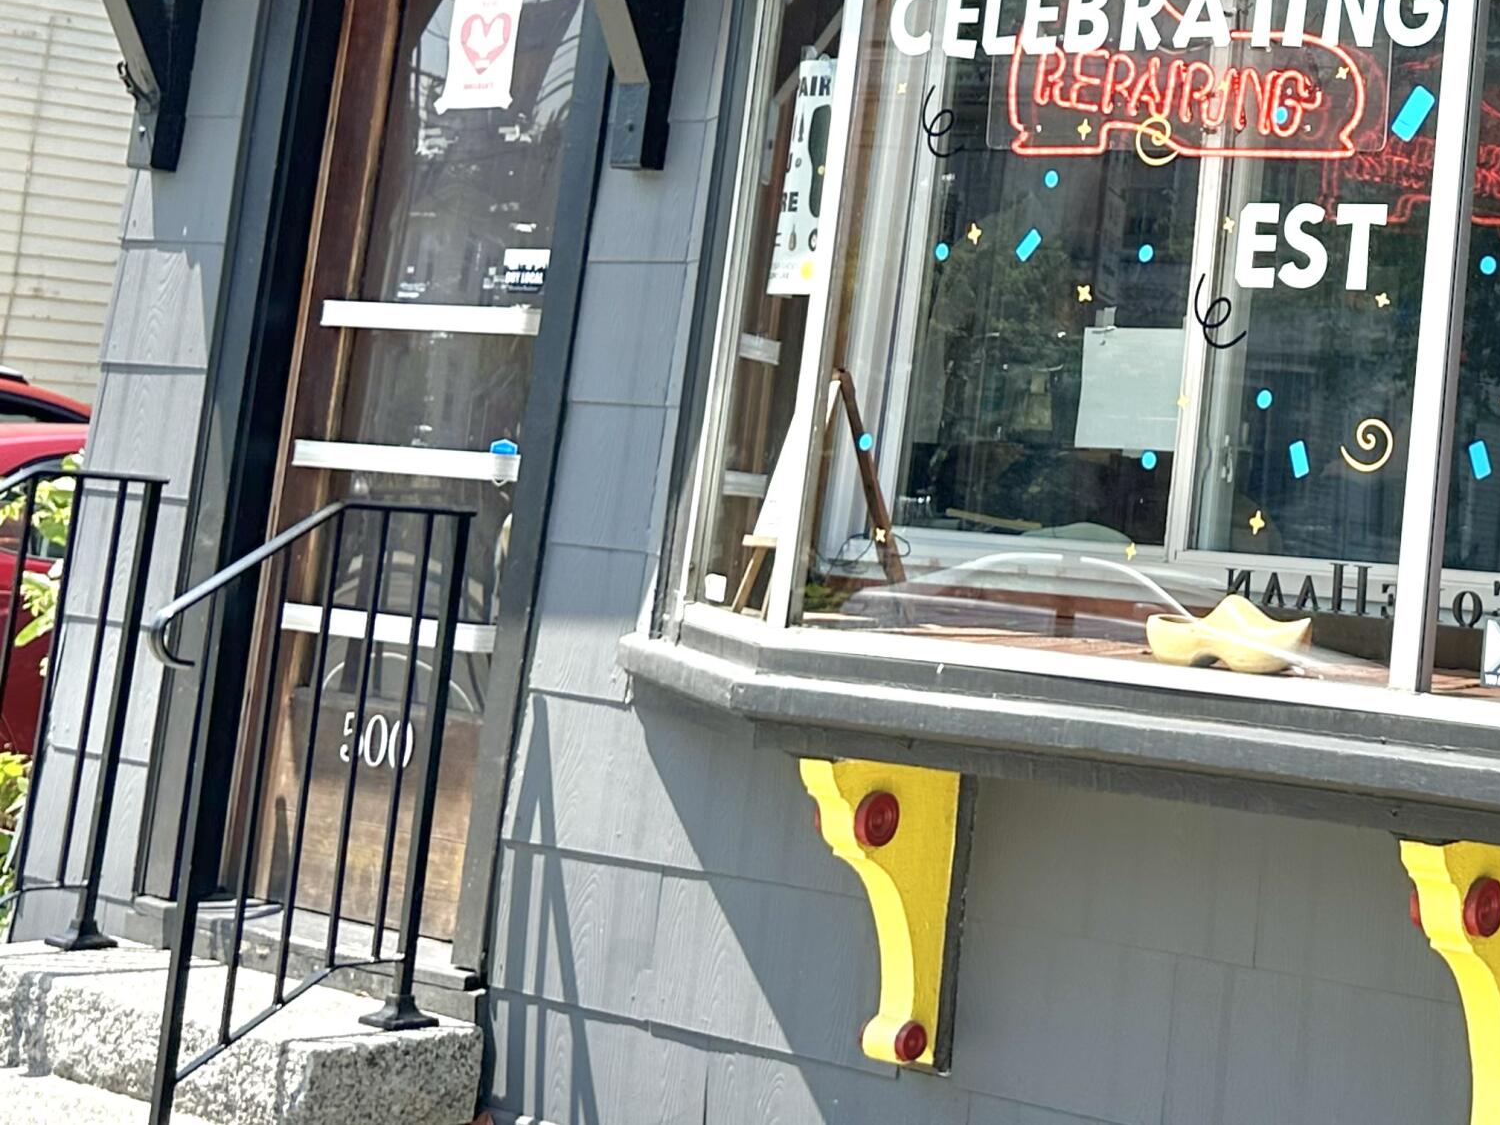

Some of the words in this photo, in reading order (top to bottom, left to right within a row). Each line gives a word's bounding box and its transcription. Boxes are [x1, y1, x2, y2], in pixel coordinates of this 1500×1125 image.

[1033, 45, 1324, 138] REPAIRING
[1233, 202, 1388, 291] EST
[339, 711, 414, 769] 500
